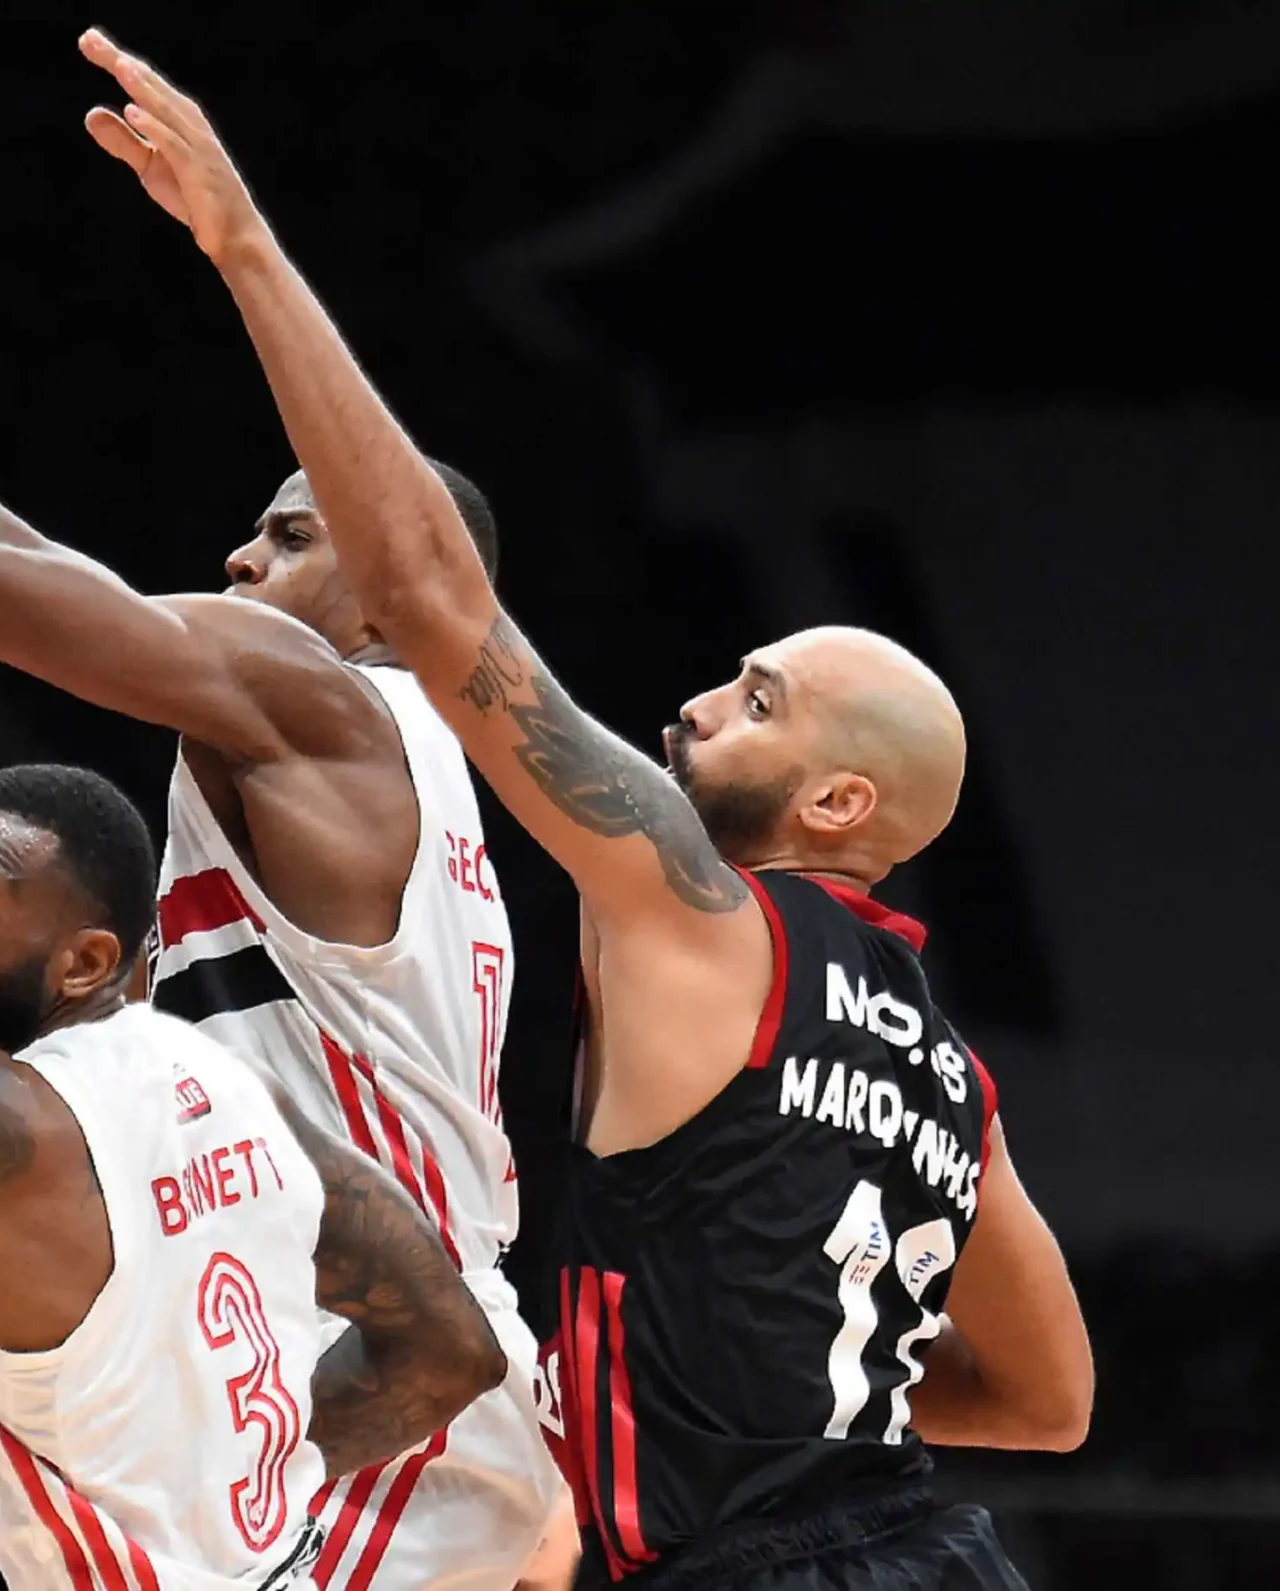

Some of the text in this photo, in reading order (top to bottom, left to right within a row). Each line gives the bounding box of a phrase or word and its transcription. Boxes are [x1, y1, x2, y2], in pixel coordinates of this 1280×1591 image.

[860, 1221, 882, 1262] TIM
[909, 1250, 940, 1285] TIM
[198, 1252, 300, 1553] 3
